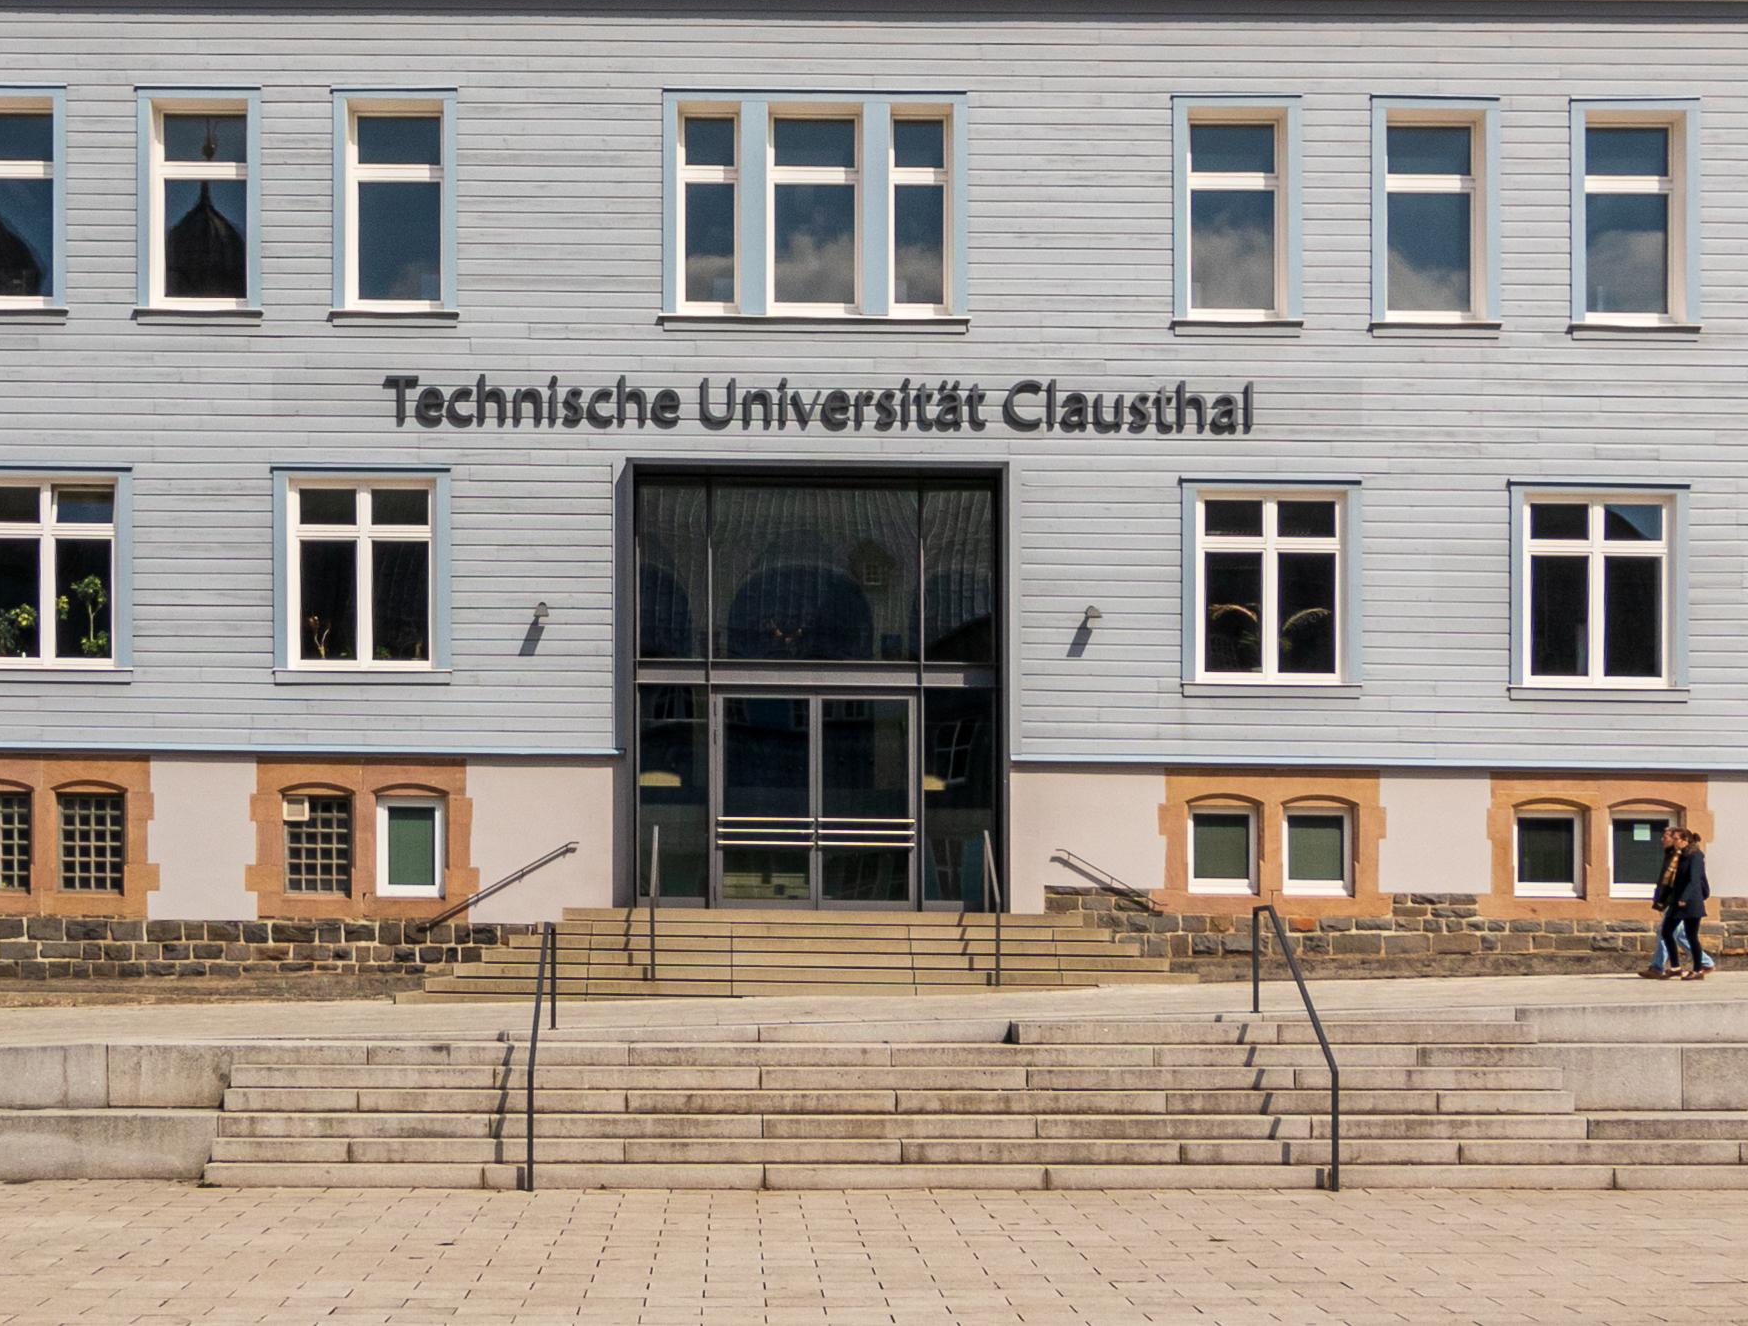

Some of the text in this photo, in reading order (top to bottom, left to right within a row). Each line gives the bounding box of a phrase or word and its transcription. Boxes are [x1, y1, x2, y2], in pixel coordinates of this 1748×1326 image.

[383, 374, 1254, 435] Technische Universität Clausthal
